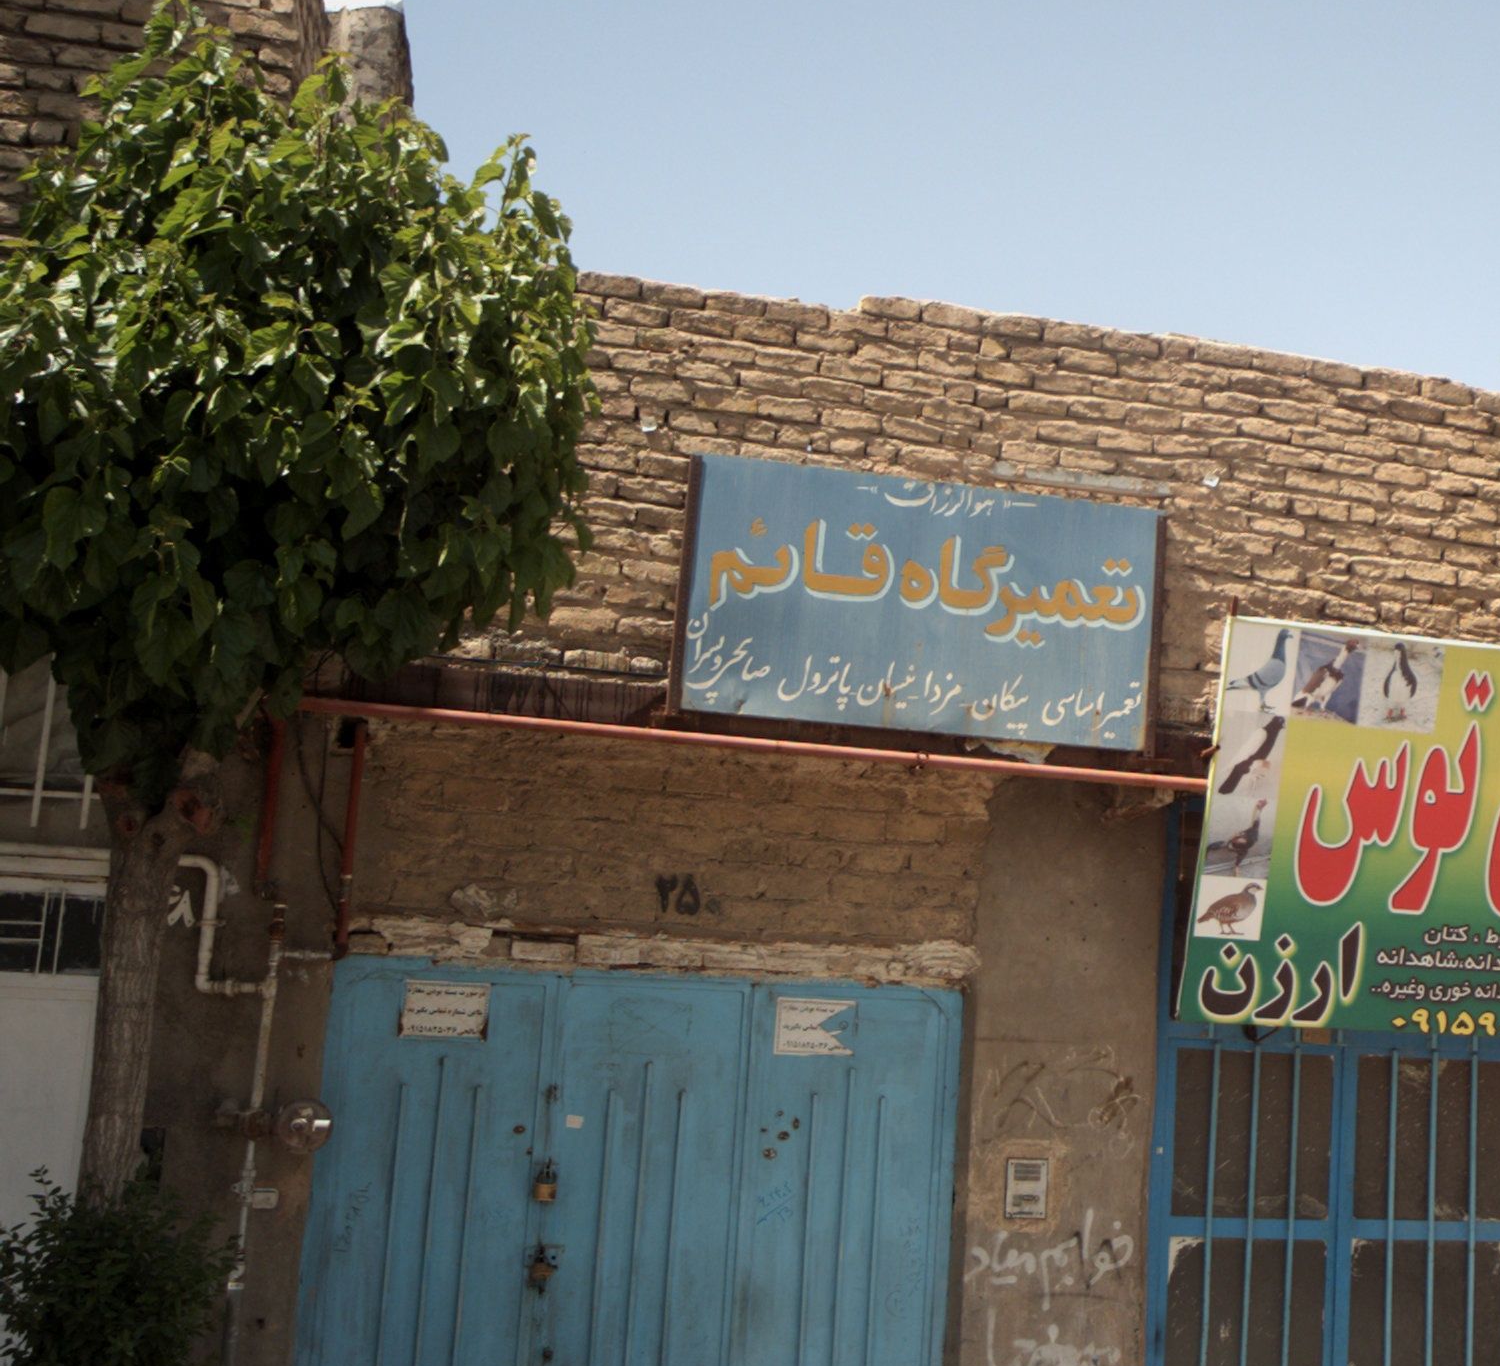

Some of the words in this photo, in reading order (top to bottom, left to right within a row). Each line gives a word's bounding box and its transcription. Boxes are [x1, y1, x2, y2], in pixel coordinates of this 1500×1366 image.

[710, 517, 895, 610] قائم
[900, 536, 1145, 648] تعمیرگاه
[777, 655, 851, 711] پاترول
[856, 660, 916, 709] نیسان
[924, 670, 962, 716] مزدا
[969, 674, 1029, 735] پیکان
[1092, 681, 1143, 739] تعمیر
[1294, 669, 1494, 915] توس
[1424, 926, 1469, 945] کتان
[1199, 921, 1365, 1026] ارزن
[1429, 982, 1471, 1001] خوری
